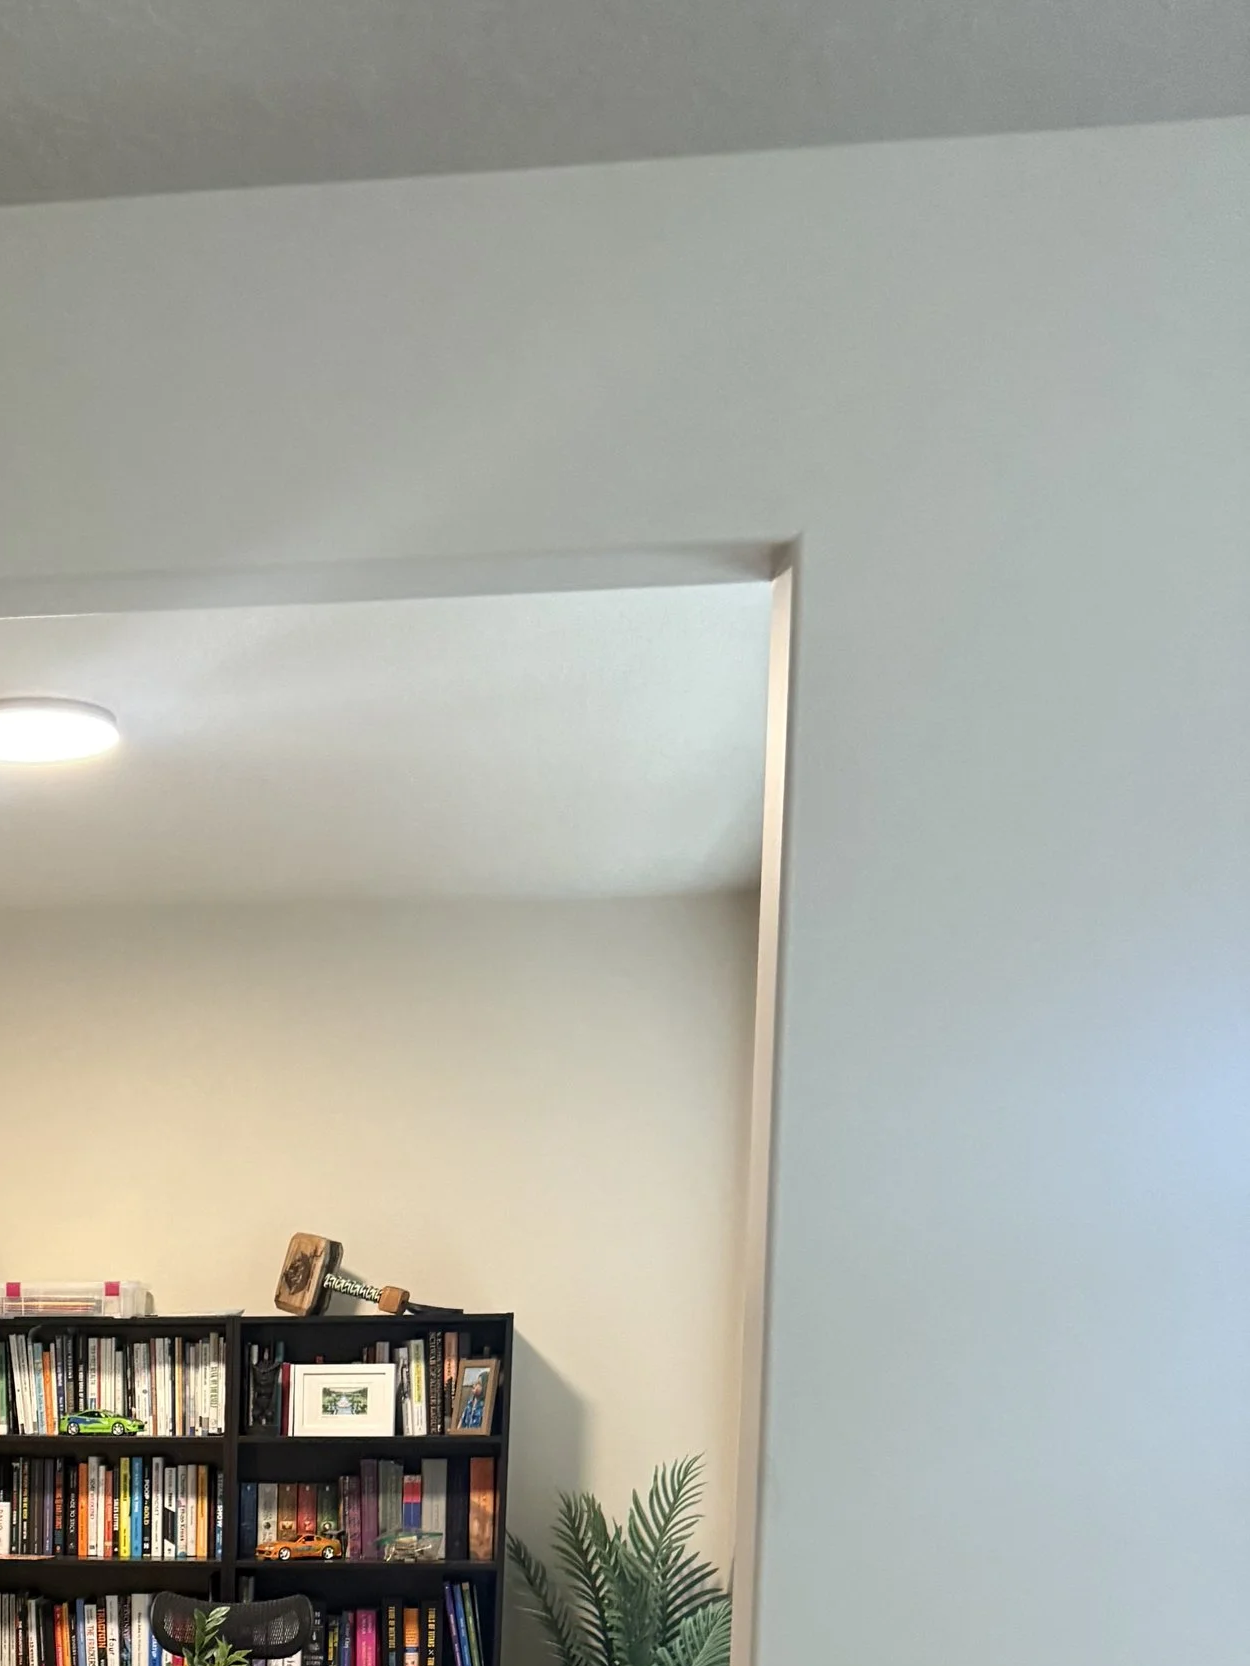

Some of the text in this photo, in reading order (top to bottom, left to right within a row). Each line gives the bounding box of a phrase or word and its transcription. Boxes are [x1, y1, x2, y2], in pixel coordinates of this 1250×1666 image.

[86, 1626, 94, 1636] THE
[97, 1608, 106, 1648] TRACTION
[427, 1631, 435, 1647] TITANS
